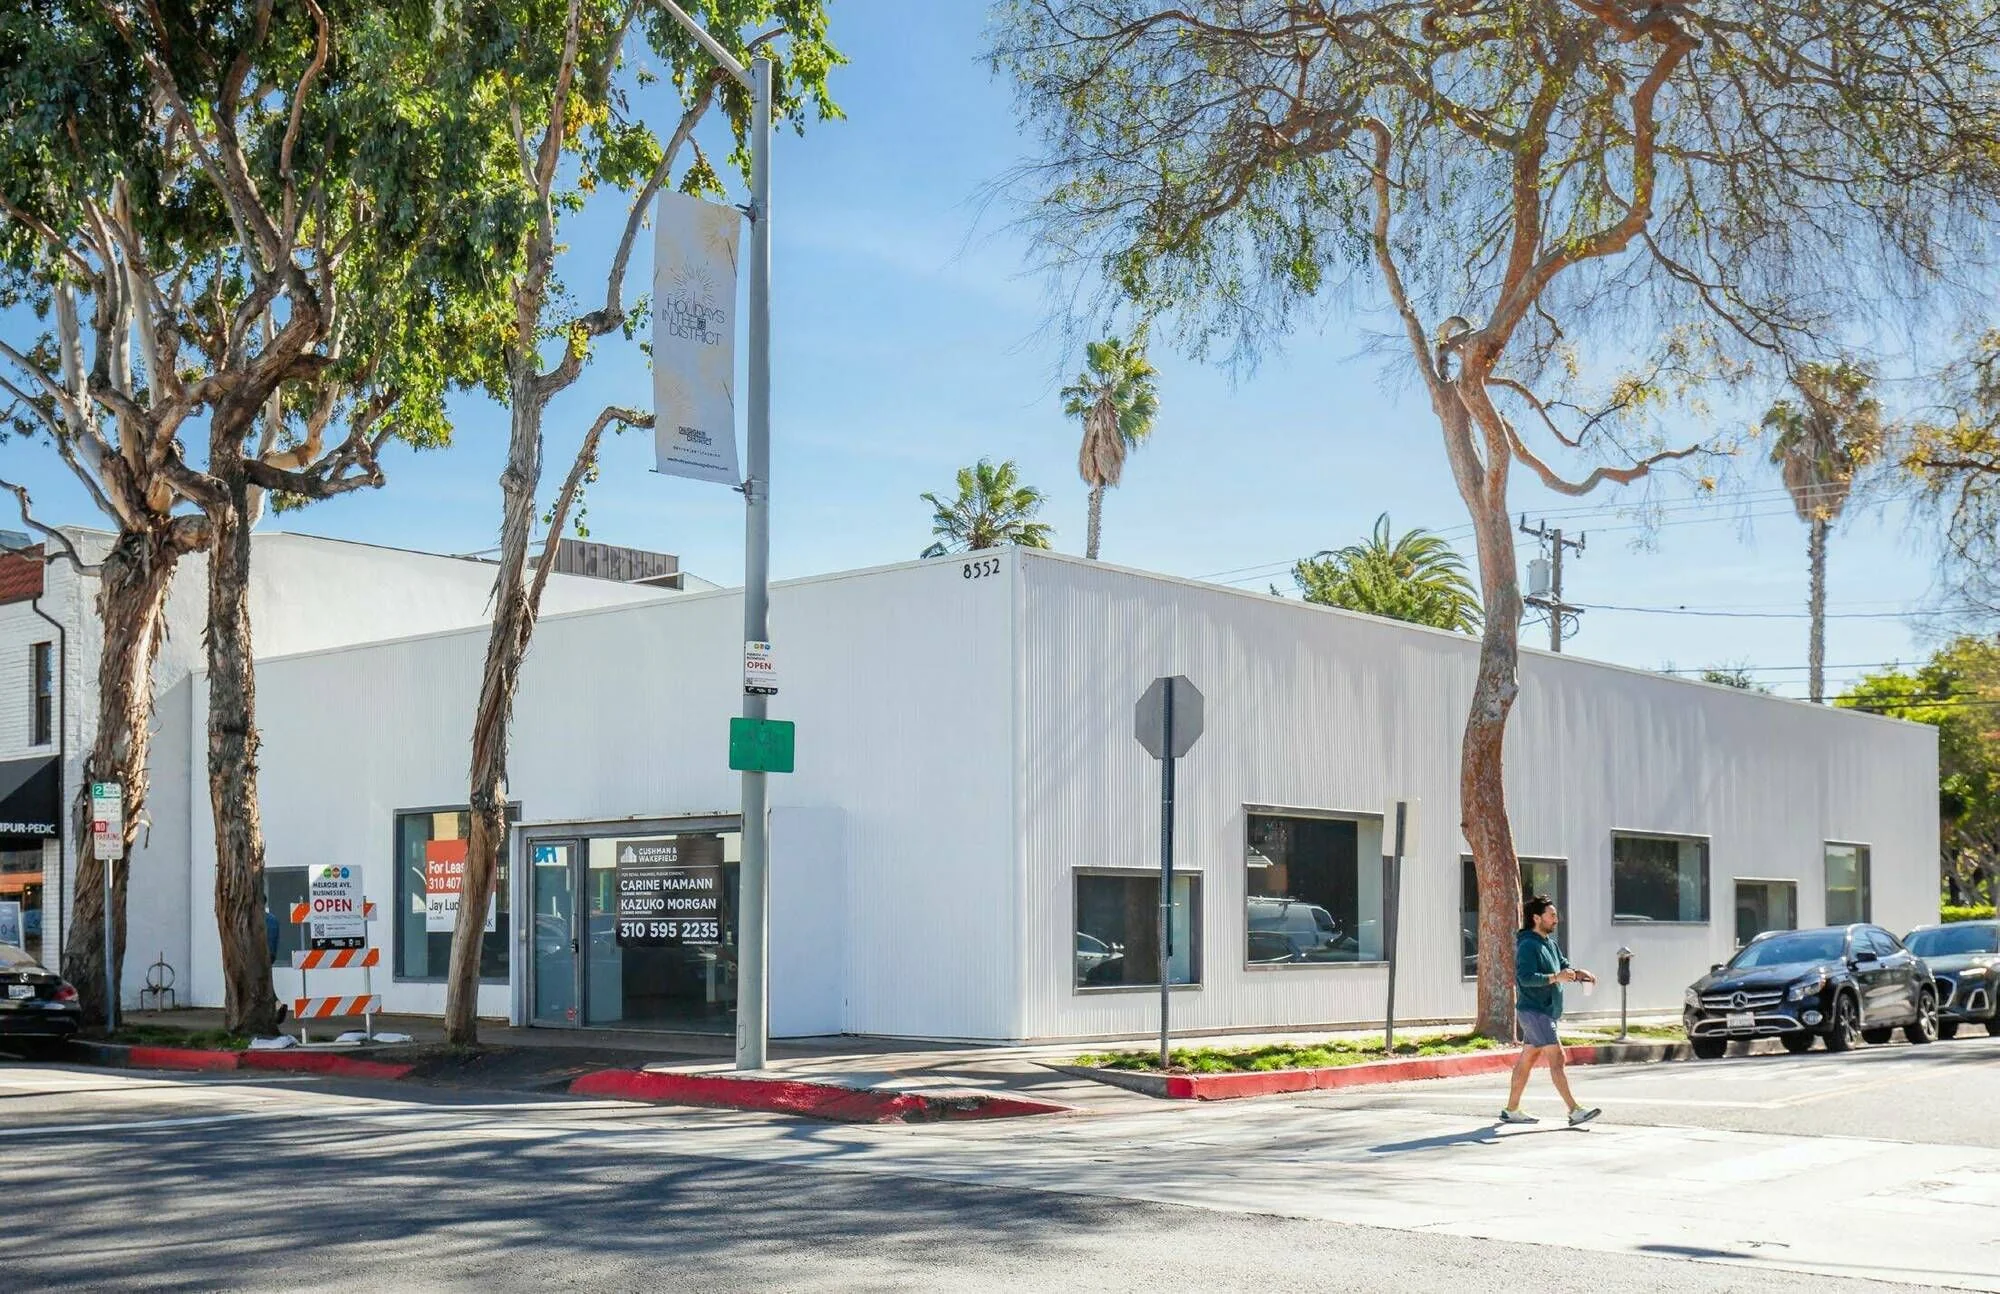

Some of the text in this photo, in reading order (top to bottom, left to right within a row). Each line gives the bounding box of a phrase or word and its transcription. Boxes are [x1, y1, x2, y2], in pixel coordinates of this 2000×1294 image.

[666, 295, 725, 324] HOLIDAYS
[670, 322, 722, 346] DISTRICT
[963, 558, 1000, 579] 8552
[746, 661, 772, 670] OPEN
[95, 786, 102, 795] 2
[95, 822, 106, 831] NO
[638, 846, 677, 855] CUSHMAN &
[638, 854, 678, 863] WAKEFIELD
[428, 860, 464, 874] For Leas
[428, 876, 461, 890] 310 407
[620, 878, 713, 891] CARINE MAMANN
[314, 899, 352, 912] OPEN
[429, 899, 444, 914] Jay
[620, 898, 717, 910] KAZUKO MORGAN
[620, 922, 719, 938] 310 595 2235
